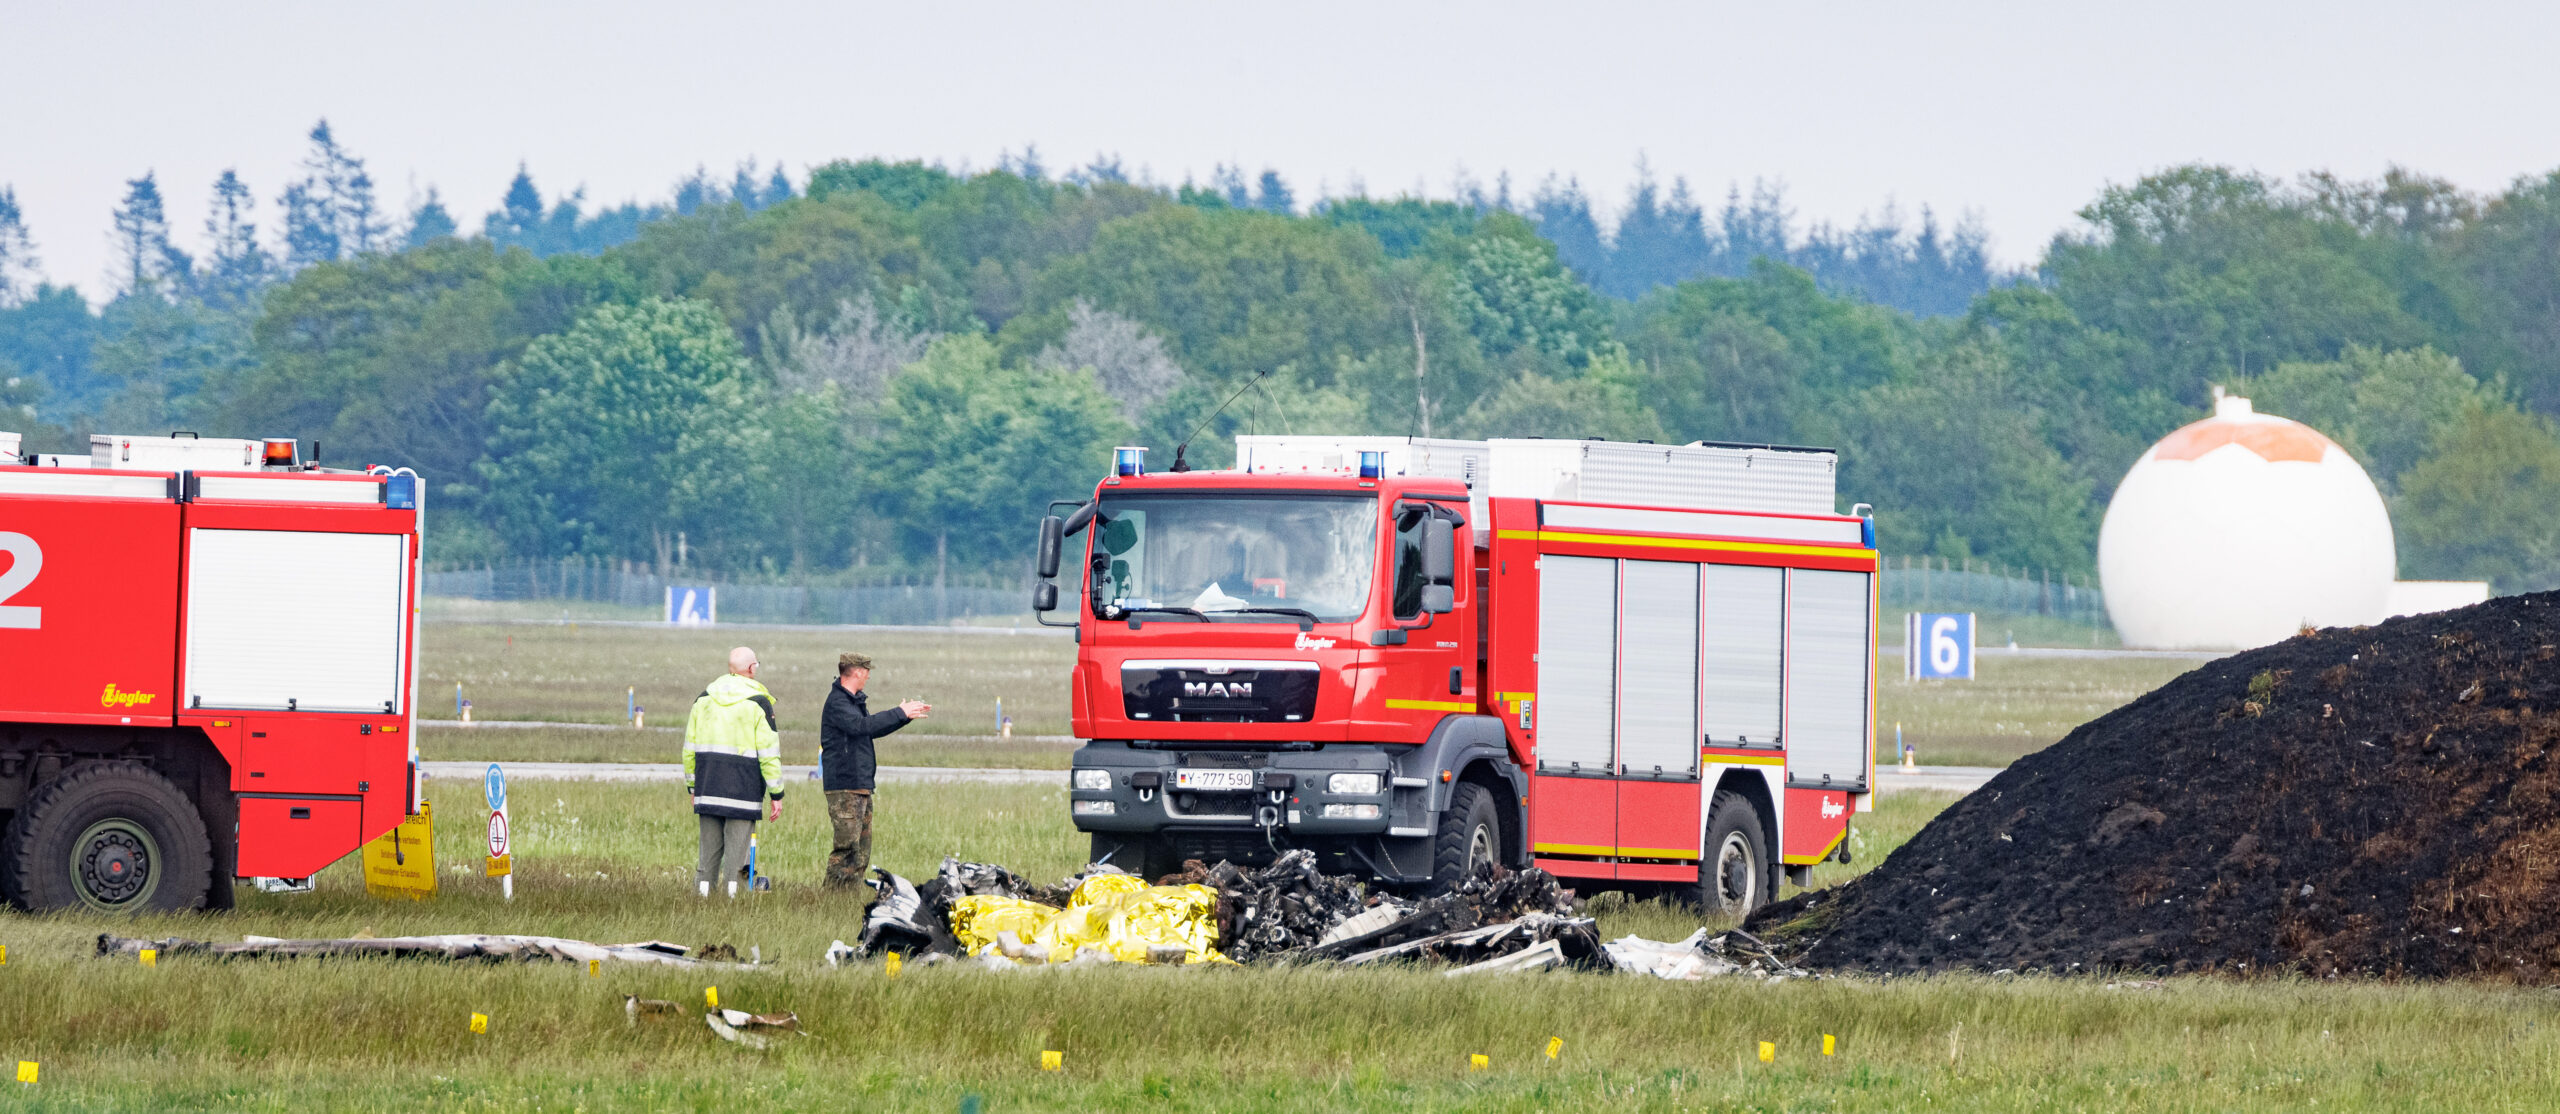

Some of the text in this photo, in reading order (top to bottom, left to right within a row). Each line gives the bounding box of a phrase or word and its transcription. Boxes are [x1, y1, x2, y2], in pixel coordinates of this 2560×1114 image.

[0, 530, 43, 630] 2
[1930, 616, 1959, 674] 6
[1184, 682, 1252, 697] MAN
[1228, 773, 1251, 786] 590
